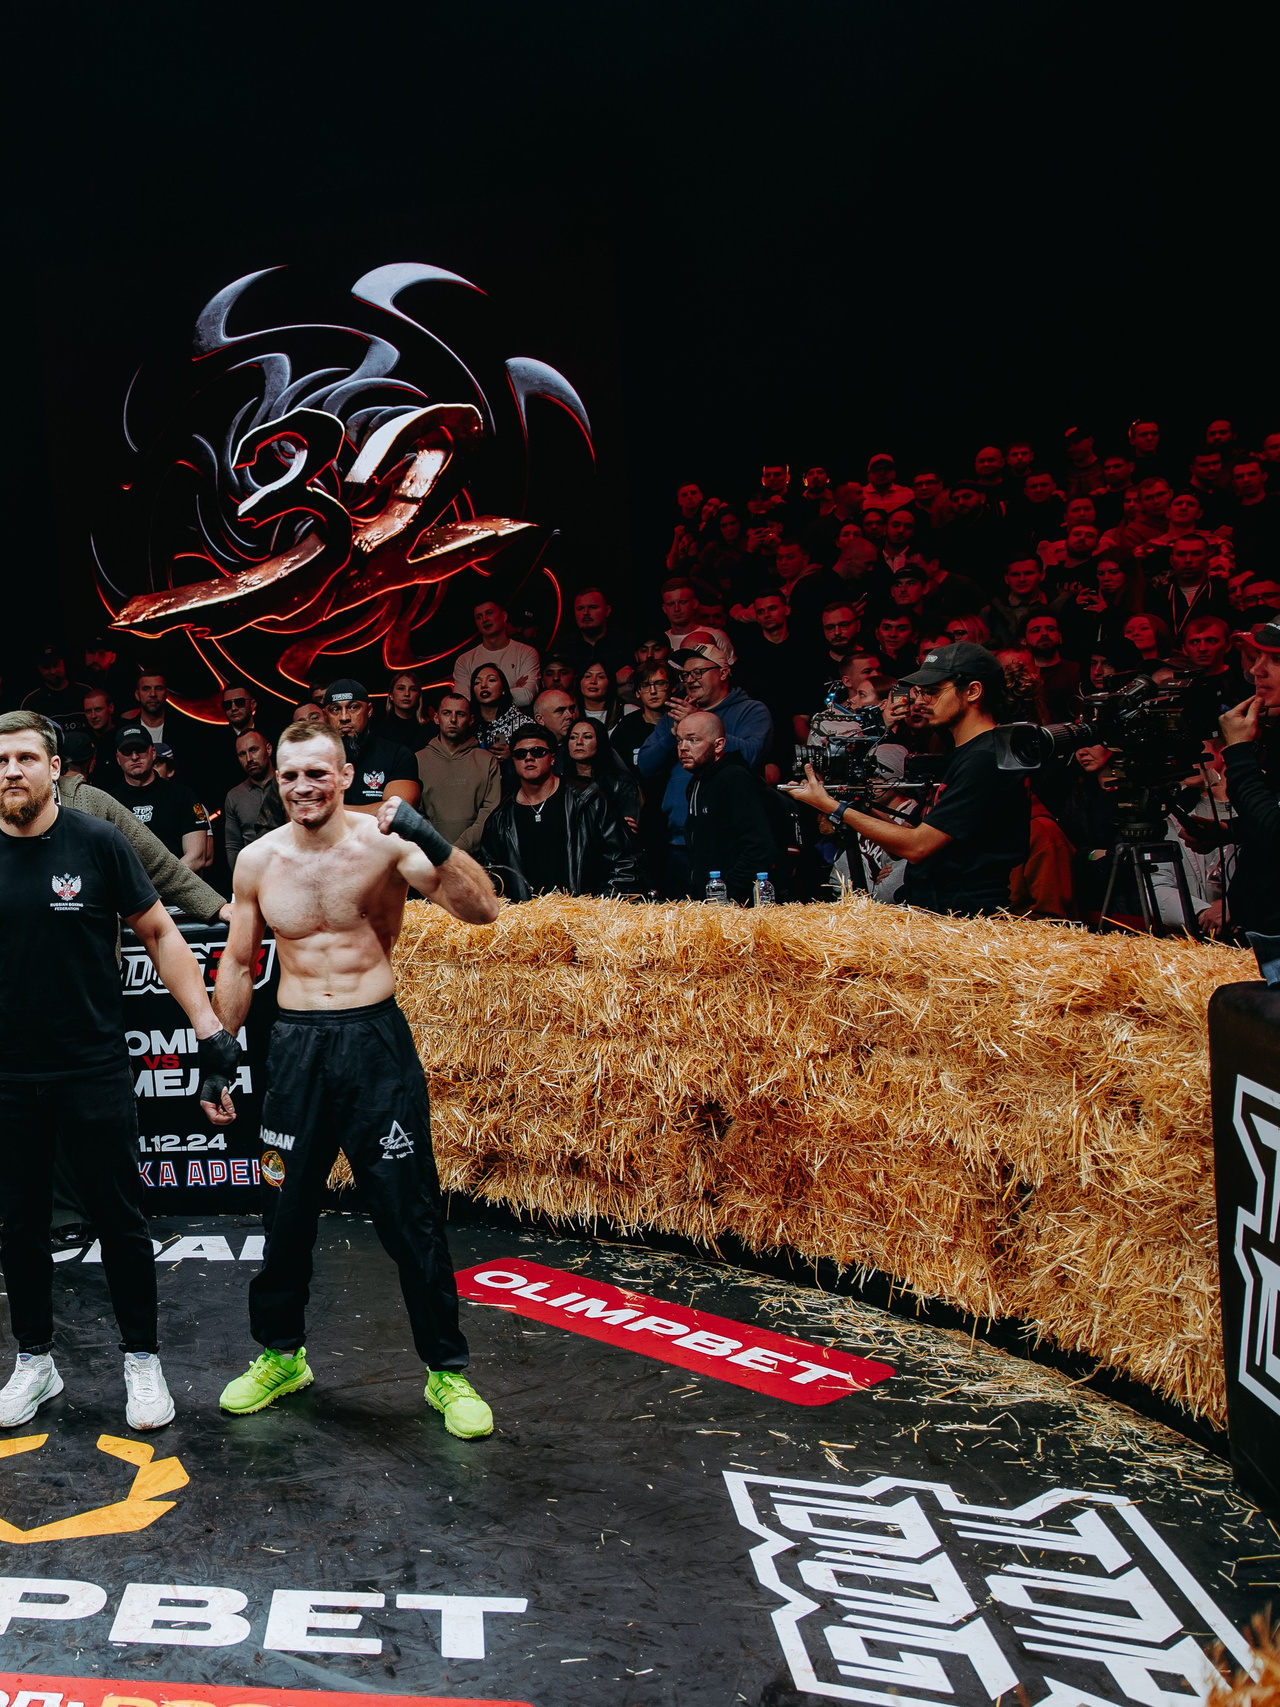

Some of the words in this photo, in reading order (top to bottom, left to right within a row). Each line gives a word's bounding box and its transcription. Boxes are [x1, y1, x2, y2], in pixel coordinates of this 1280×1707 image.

[143, 1055, 180, 1070] VS
[139, 1133, 227, 1152] 1.12.24
[472, 1269, 856, 1385] OLIMPBET
[769, 1492, 1020, 1701] DOG
